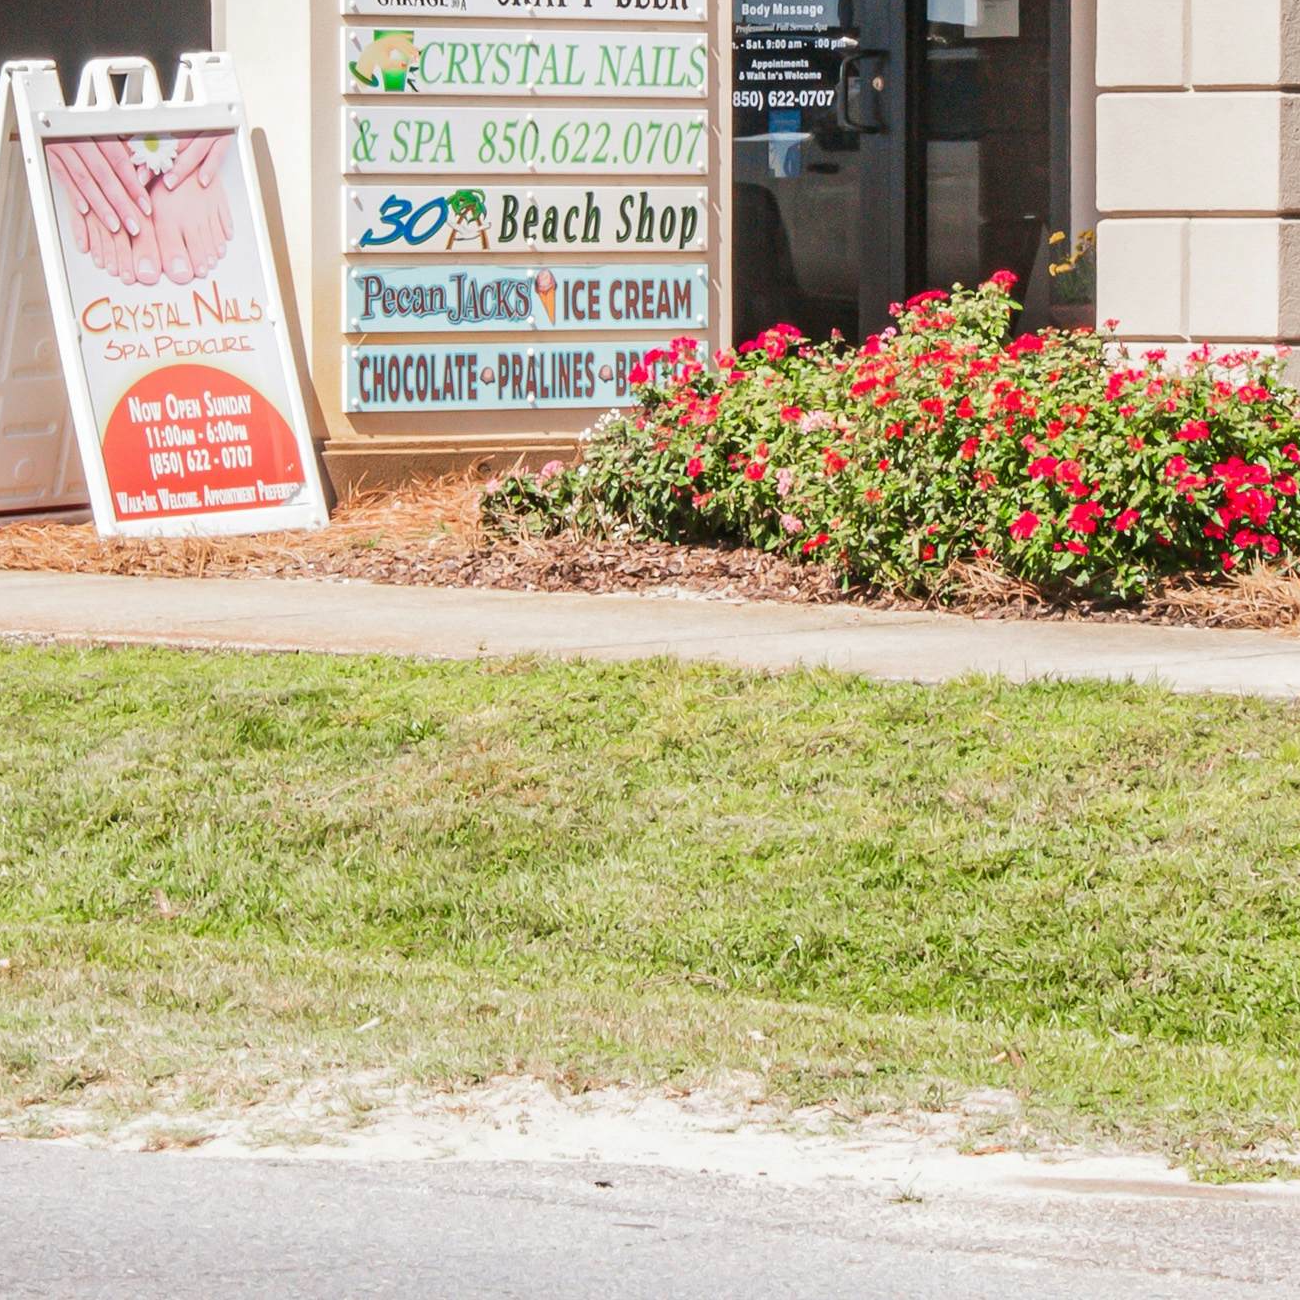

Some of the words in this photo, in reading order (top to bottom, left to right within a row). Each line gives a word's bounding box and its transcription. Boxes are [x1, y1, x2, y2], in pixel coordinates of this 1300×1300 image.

[741, 4, 770, 18] Body
[772, 4, 824, 17] Massage
[746, 39, 764, 50] Sat.
[766, 39, 786, 49] 9:00
[788, 40, 802, 49] am
[419, 42, 585, 86] CRYSTAL
[595, 45, 706, 87] NAILS
[739, 71, 744, 80] &
[746, 71, 766, 80] Walk
[767, 71, 783, 80] In's
[784, 71, 822, 80] Welcome
[751, 59, 809, 70] Appointments
[732, 90, 764, 111] 850)
[768, 90, 835, 107] 622-0707
[352, 120, 379, 163] &
[390, 120, 455, 163] SPA
[477, 120, 703, 165] 850.622.0707
[498, 192, 601, 243] Beach
[615, 192, 698, 249] Shop
[81, 296, 191, 333] CRYSTAL
[192, 280, 263, 326] NAILS
[362, 273, 447, 318] Pecan
[563, 280, 599, 320] ICE
[609, 280, 692, 320] CREAM
[104, 339, 150, 360] SPA
[154, 335, 256, 357] PEDICURE
[359, 354, 477, 403] CHOCOLATE
[498, 353, 595, 401] PRALINES
[149, 451, 185, 480] (850)
[187, 449, 211, 472] 622
[221, 445, 252, 468] 0707
